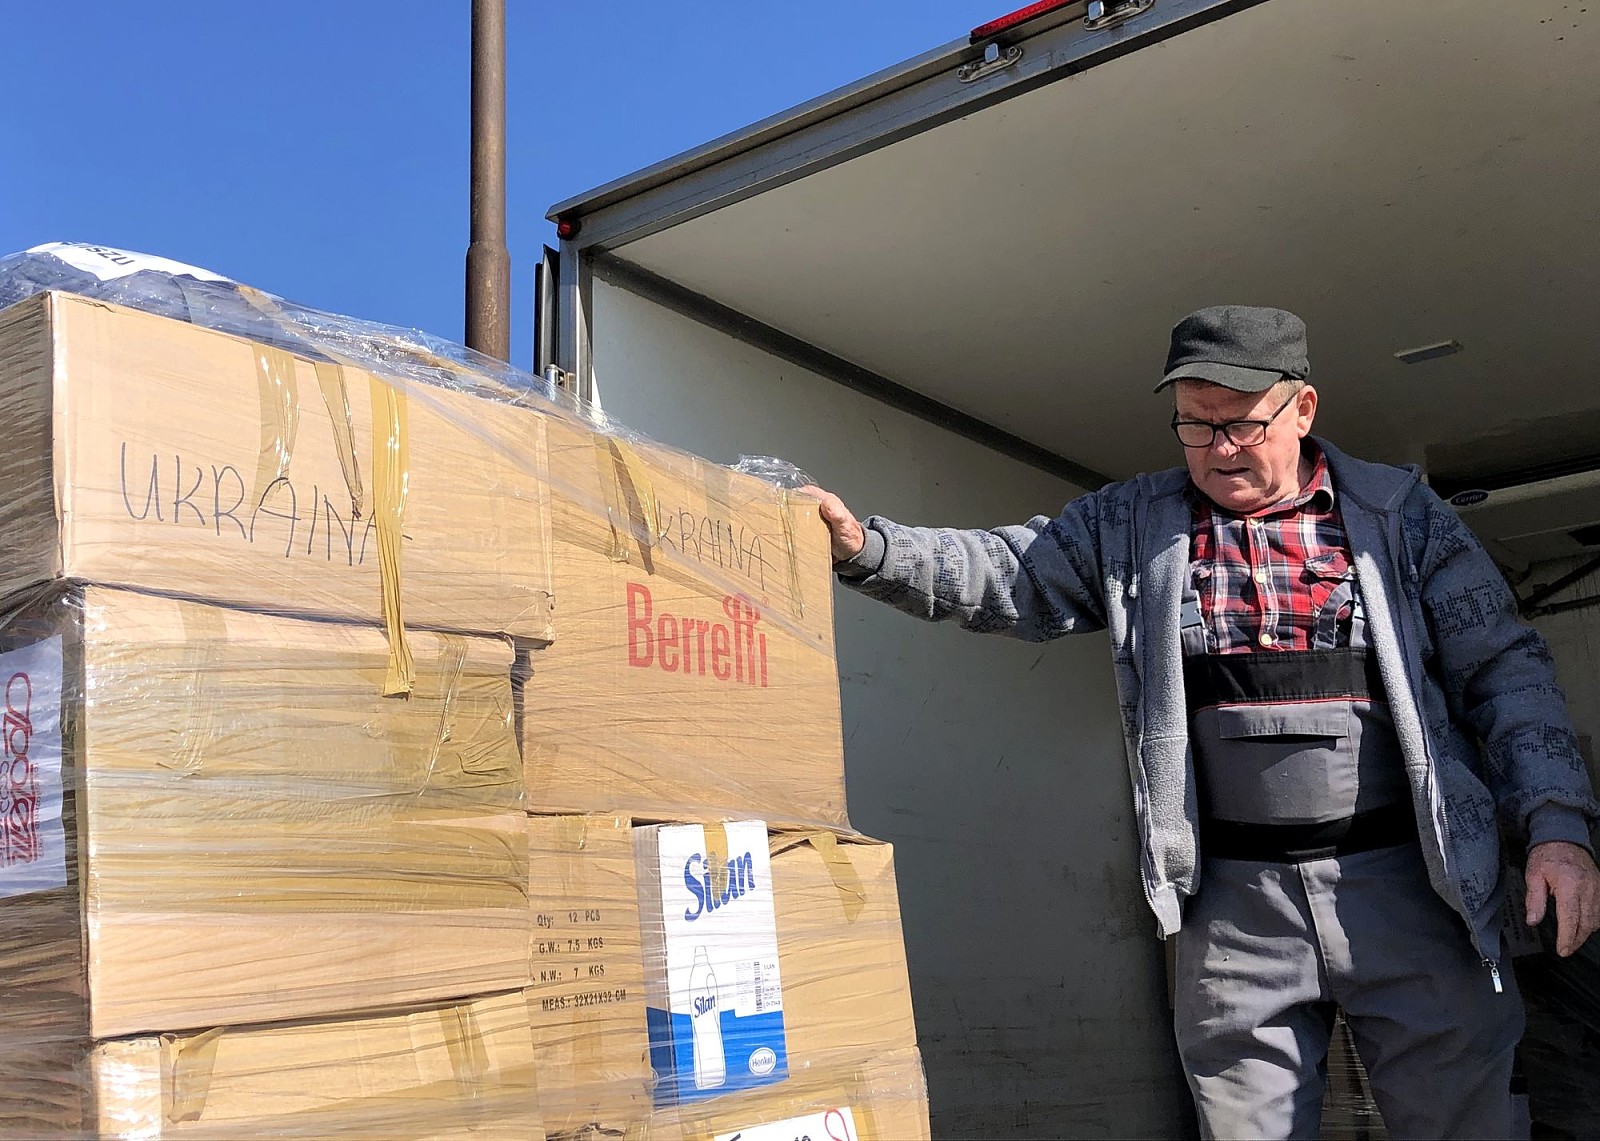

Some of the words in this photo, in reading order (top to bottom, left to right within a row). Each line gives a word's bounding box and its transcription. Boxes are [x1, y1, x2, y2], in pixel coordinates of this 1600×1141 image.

[684, 852, 756, 922] Silan
[537, 914, 554, 929] Qty:
[569, 912, 578, 923] 12
[585, 909, 601, 922] PCS
[539, 941, 560, 954] G.W.:
[568, 939, 580, 952] 7.5
[587, 937, 604, 950] KGS
[540, 969, 562, 982] N.W.:
[573, 967, 579, 978] 7
[588, 964, 605, 977] KGS
[574, 990, 613, 1008] 32X21X32
[615, 989, 627, 1002] CM
[694, 995, 716, 1019] Silan
